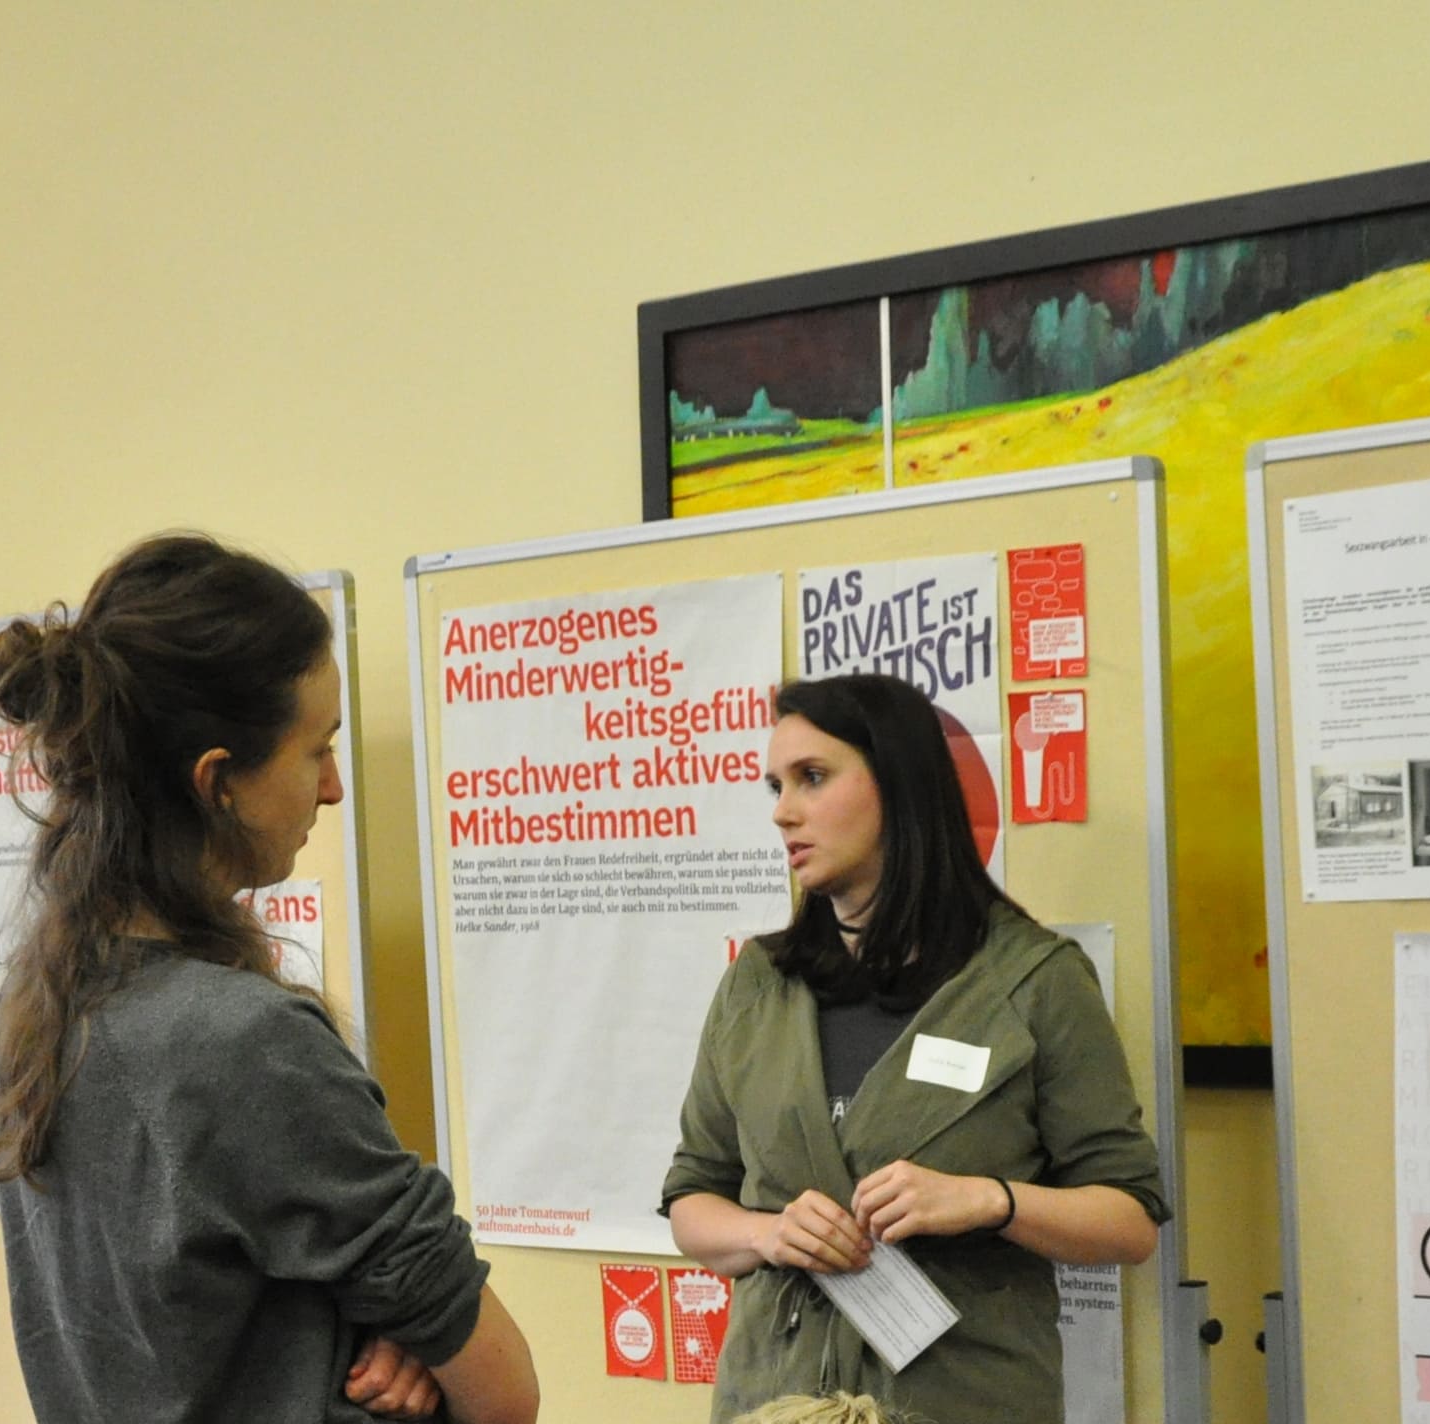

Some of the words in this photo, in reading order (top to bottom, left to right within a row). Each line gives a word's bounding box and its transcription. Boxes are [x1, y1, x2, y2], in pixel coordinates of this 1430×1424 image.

[802, 570, 863, 624] DAS
[444, 604, 658, 656] Anerzogenes
[804, 578, 938, 676] PRIVATE
[942, 588, 979, 625] IST
[853, 616, 992, 702] ITISCH
[445, 645, 684, 704] Minderwertig-
[446, 752, 621, 799] erschwert
[632, 743, 761, 788] aktives
[449, 801, 696, 847] Mitbestimmen
[452, 858, 476, 870] Man
[477, 856, 517, 871] gewährt
[520, 857, 542, 868] zwar
[543, 855, 561, 867] den
[564, 854, 597, 867] Frauen
[599, 851, 662, 865] Redefreiheit,
[664, 850, 714, 866] ergründet
[717, 849, 739, 862] aber
[742, 848, 768, 861] nicht
[770, 848, 784, 860] die
[453, 874, 501, 886] Ursachen,
[503, 873, 536, 884] warum
[537, 871, 550, 882] sie
[551, 869, 571, 882] sich
[573, 873, 584, 882] so
[585, 869, 623, 882] schlecht
[625, 867, 677, 881] bewähren,
[678, 869, 713, 879] warum
[715, 866, 729, 878] sie
[731, 865, 763, 880] passiv
[765, 864, 788, 877] sind,
[453, 889, 487, 901] warum
[489, 888, 503, 899] sie
[530, 887, 538, 898] in
[539, 886, 556, 898] der
[557, 886, 580, 901] Lage
[581, 885, 603, 898] sind,
[605, 885, 619, 897] die
[620, 882, 701, 898] Verbandspolitik
[702, 882, 719, 895] mit
[722, 884, 733, 894] zu
[735, 881, 788, 895] vollziehen,
[265, 894, 318, 923] ans
[455, 905, 476, 917] aber
[478, 903, 504, 916] nicht
[506, 903, 528, 915] dazu
[530, 903, 539, 915] in
[540, 902, 556, 915] der
[558, 902, 580, 917] Lage
[581, 901, 604, 915] sind,
[607, 901, 619, 913] sie
[621, 900, 645, 913] auch
[648, 900, 665, 912] mit
[667, 902, 678, 912] zu
[680, 899, 740, 912] bestimmen.
[483, 917, 520, 934] Sander,
[476, 1204, 489, 1217] 50
[491, 1203, 518, 1217] Jahre
[519, 1205, 591, 1222] Tomatenwurf
[477, 1217, 576, 1237] auftomatenbasis.de
[1060, 1276, 1117, 1292] beharrten
